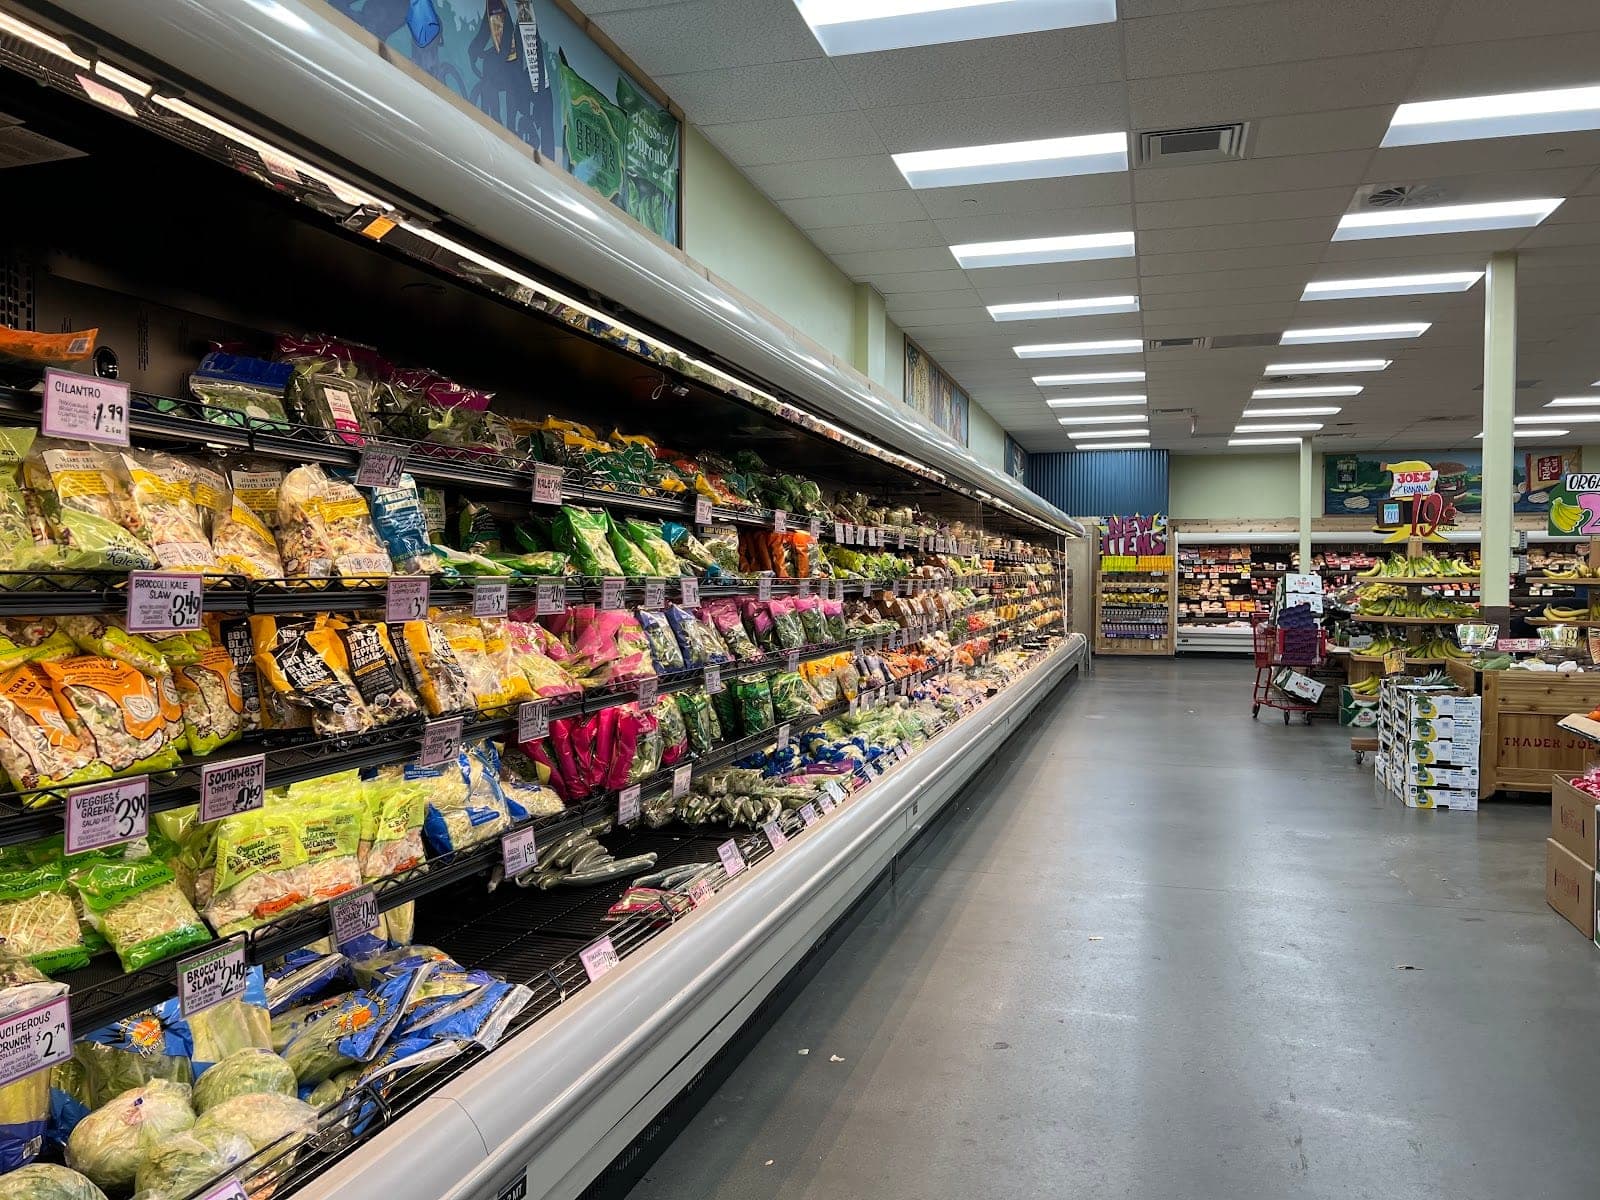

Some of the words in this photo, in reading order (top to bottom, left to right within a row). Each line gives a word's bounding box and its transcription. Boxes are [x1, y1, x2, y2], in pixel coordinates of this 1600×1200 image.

[627, 127, 668, 168] Sprouts
[55, 380, 101, 399] CILANTRO
[1542, 458, 1551, 480] Ridge
[1550, 458, 1558, 473] Cut
[1397, 472, 1431, 483] JOE'S
[1108, 514, 1154, 536] NEW
[1102, 532, 1165, 556] ITEMS
[106, 552, 133, 567] Kale
[134, 579, 168, 589] BROCCOLI
[170, 581, 189, 590] KALE
[149, 590, 172, 600] SLAW
[228, 646, 252, 657] PEPP
[349, 636, 378, 652] BLACK
[8, 677, 28, 694] ERN
[1503, 736, 1561, 749] TRADER
[75, 792, 115, 810] VEGGIES
[81, 801, 115, 819] GREENS
[81, 819, 100, 828] SALAD
[141, 869, 168, 887] Slaw
[191, 947, 233, 968] ORGANIC
[186, 956, 226, 984] BROCCOLI
[191, 972, 216, 993] SLAW
[0, 1010, 51, 1040] UCIFEROUS
